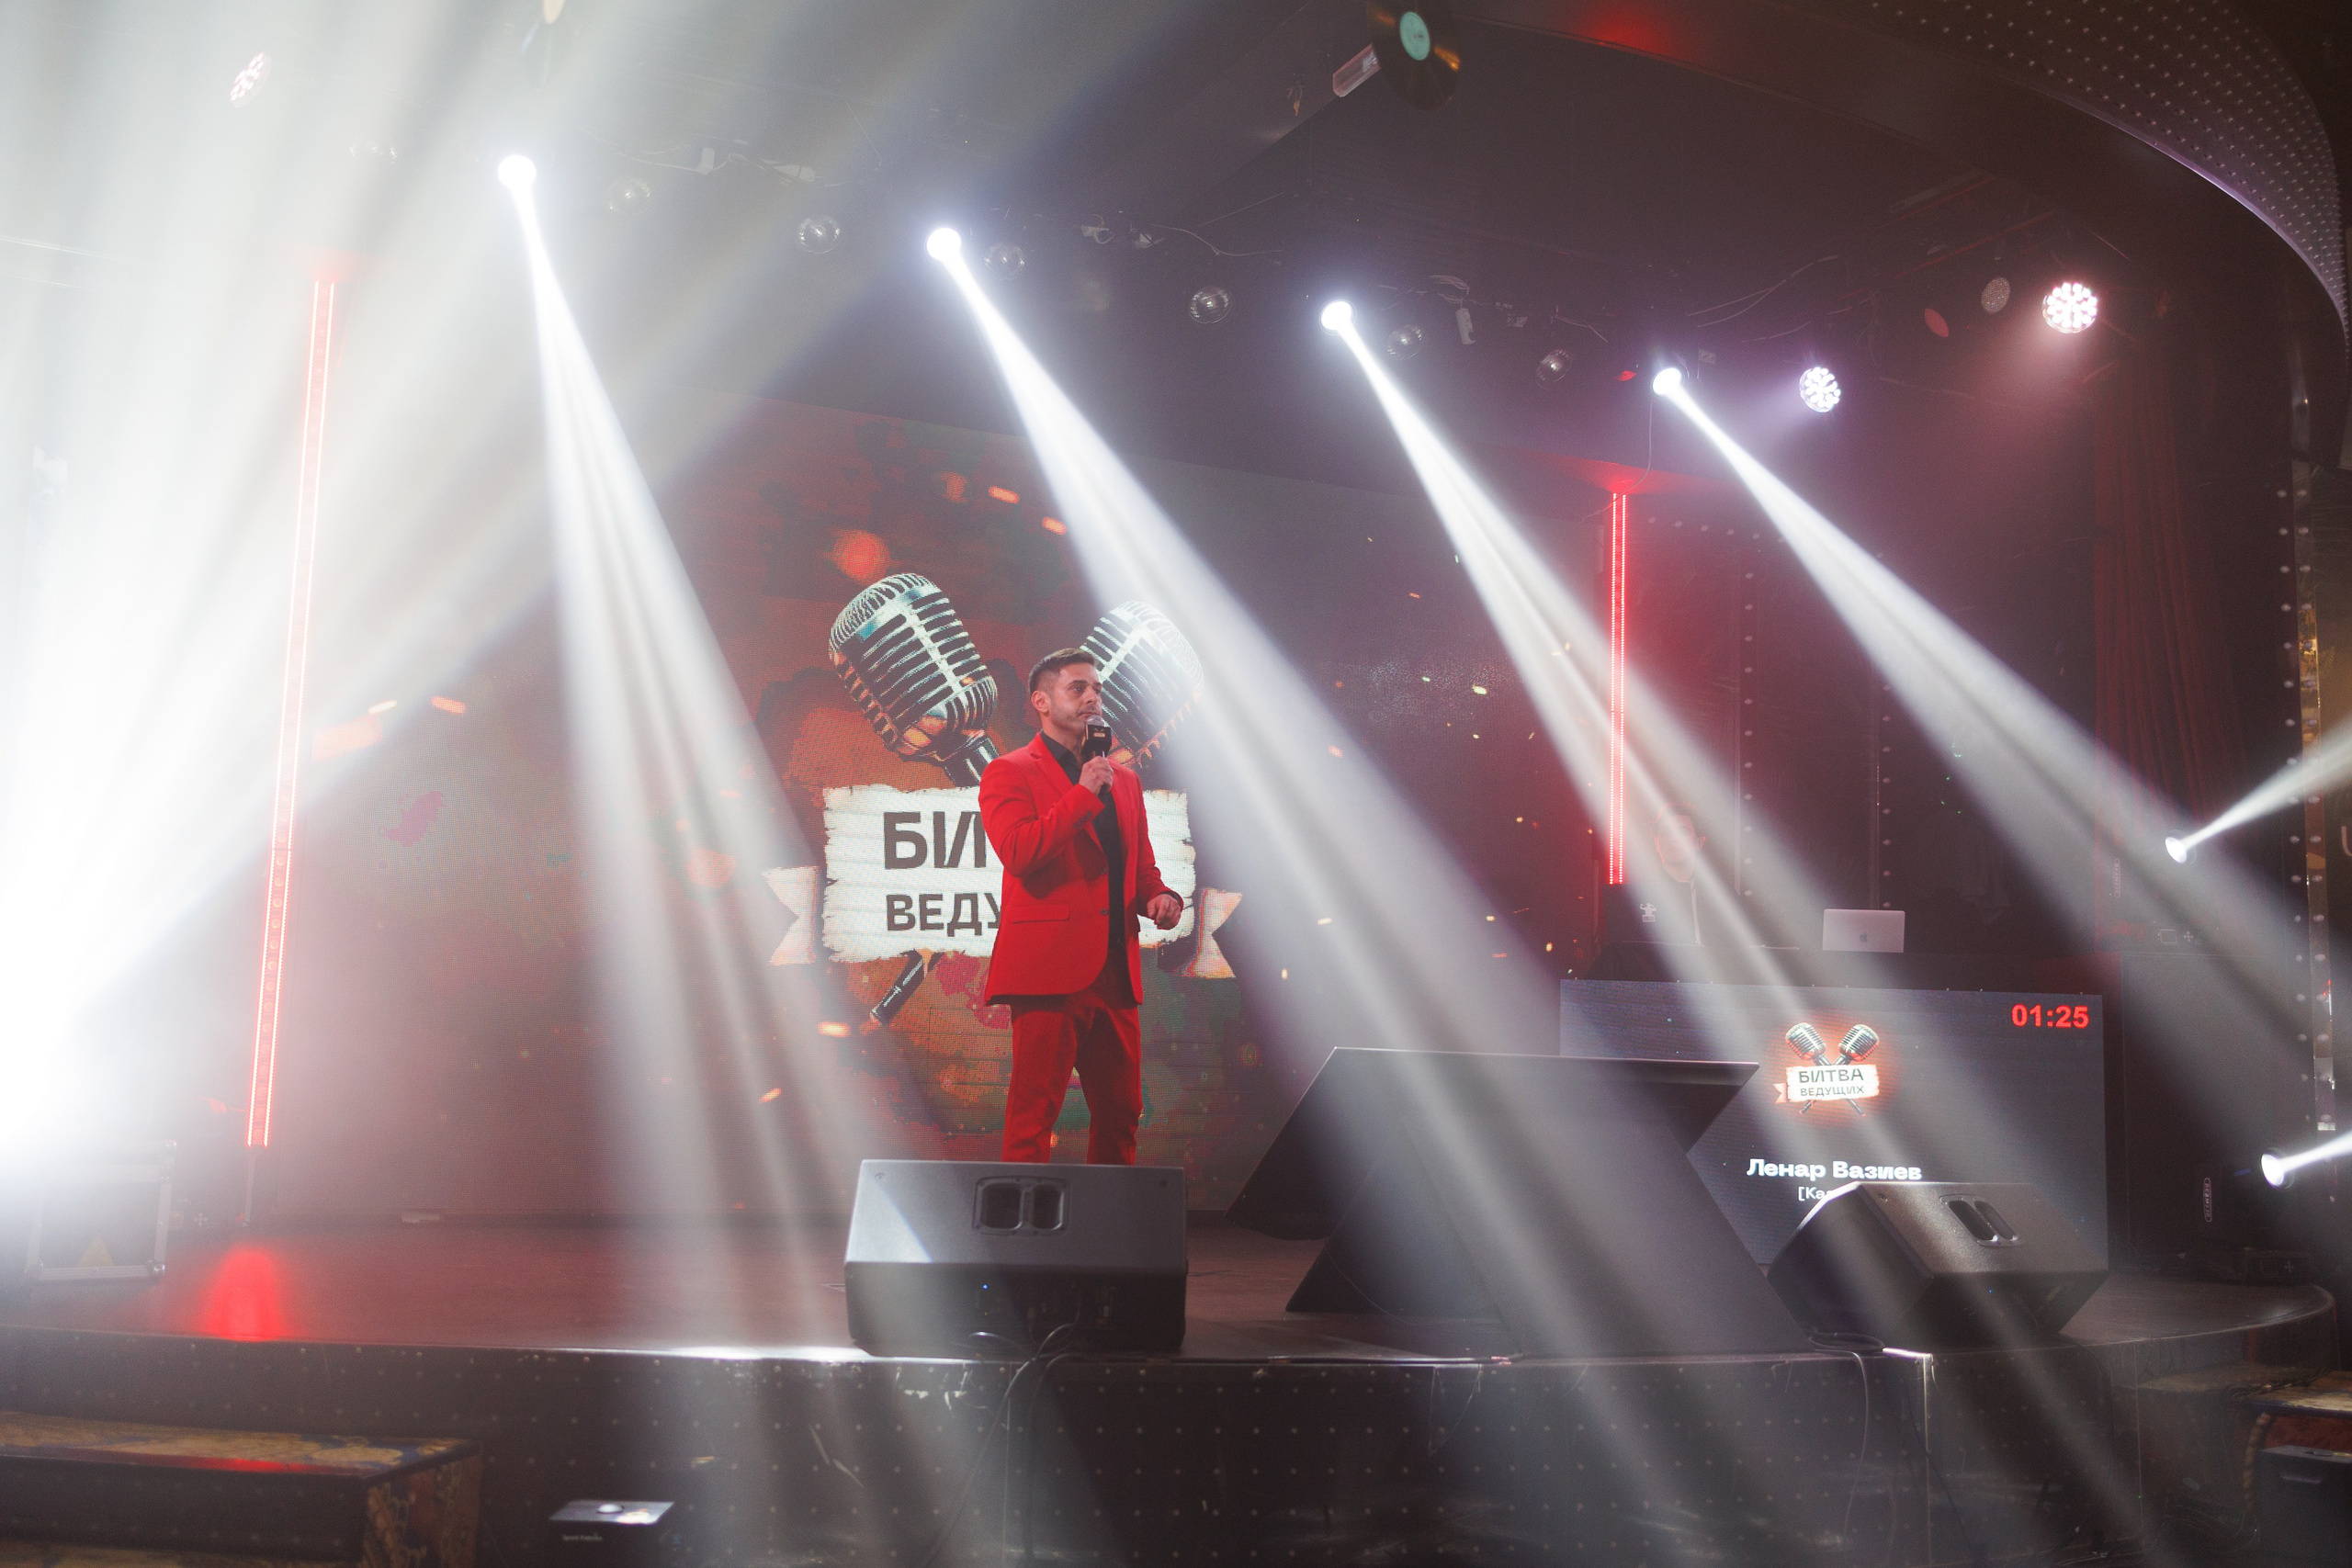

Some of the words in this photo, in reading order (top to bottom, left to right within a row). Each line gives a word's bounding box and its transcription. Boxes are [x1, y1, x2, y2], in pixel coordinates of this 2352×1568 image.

[886, 892, 1002, 937] ВЕДУ
[2011, 1004, 2089, 1028] 01:25
[1798, 1068, 1864, 1083] БИТВА
[1800, 1085, 1865, 1097] ВЕДУЩИХ
[1746, 1158, 1826, 1181] Ленар
[1832, 1160, 1922, 1180] Вазиев
